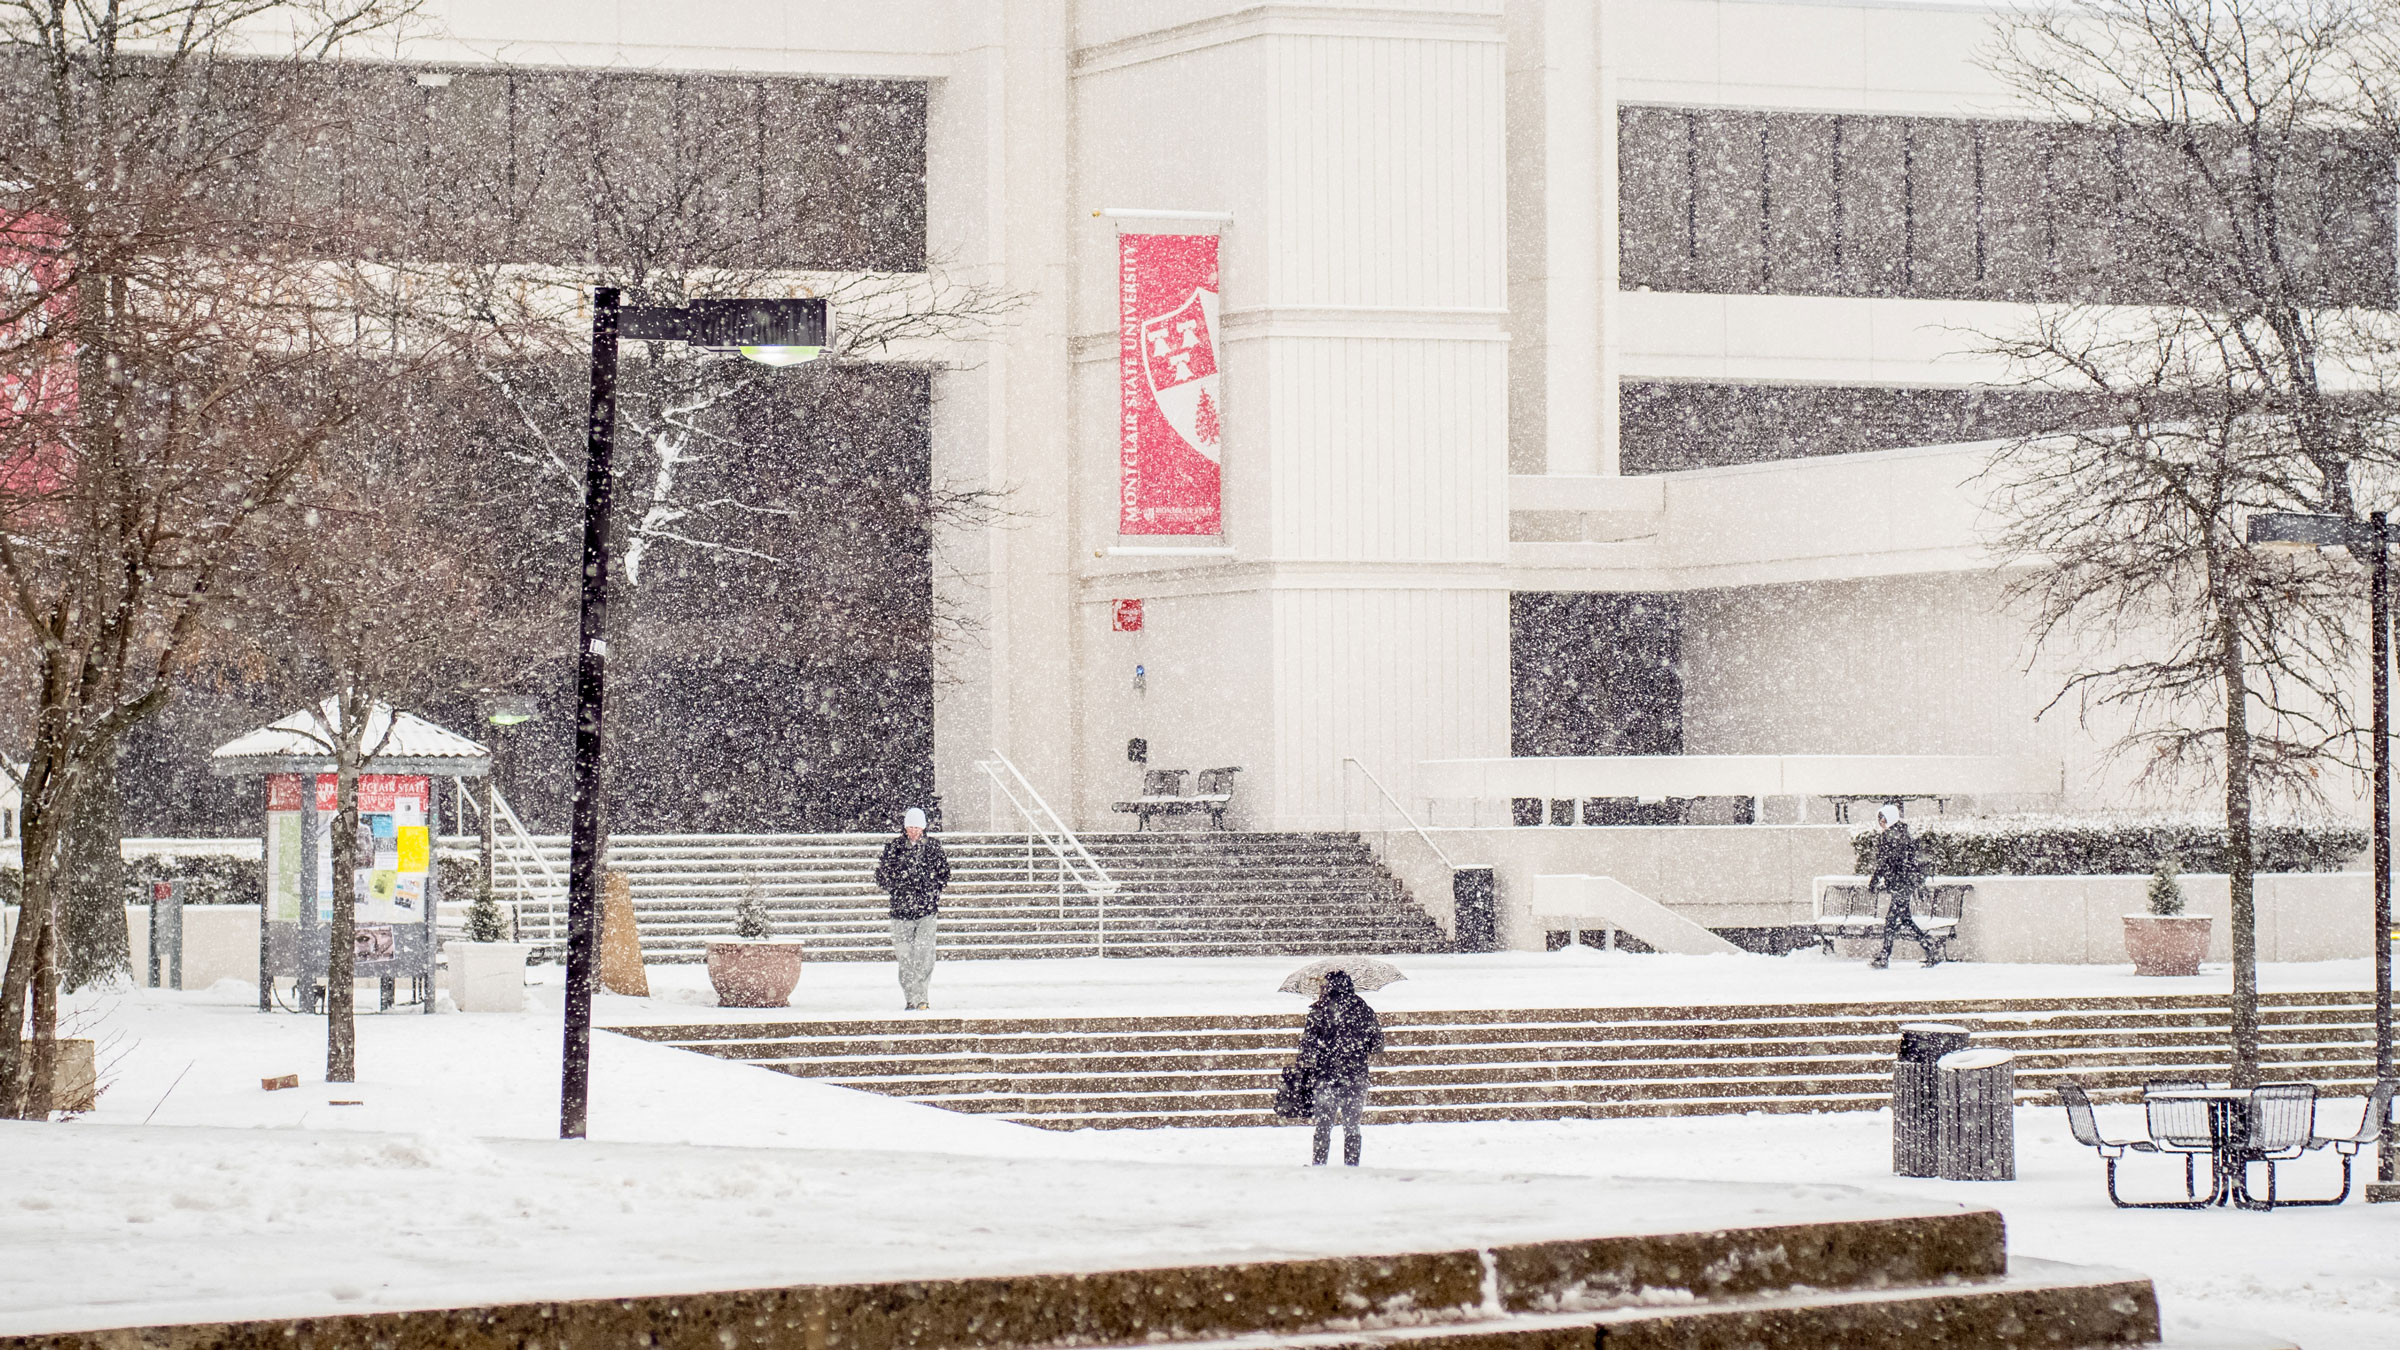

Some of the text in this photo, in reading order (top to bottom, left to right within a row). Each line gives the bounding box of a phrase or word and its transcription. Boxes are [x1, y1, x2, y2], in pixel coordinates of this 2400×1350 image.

[1124, 244, 1139, 521] MONTCLAIR STATE UNIVERSITY
[398, 782, 425, 793] STATE
